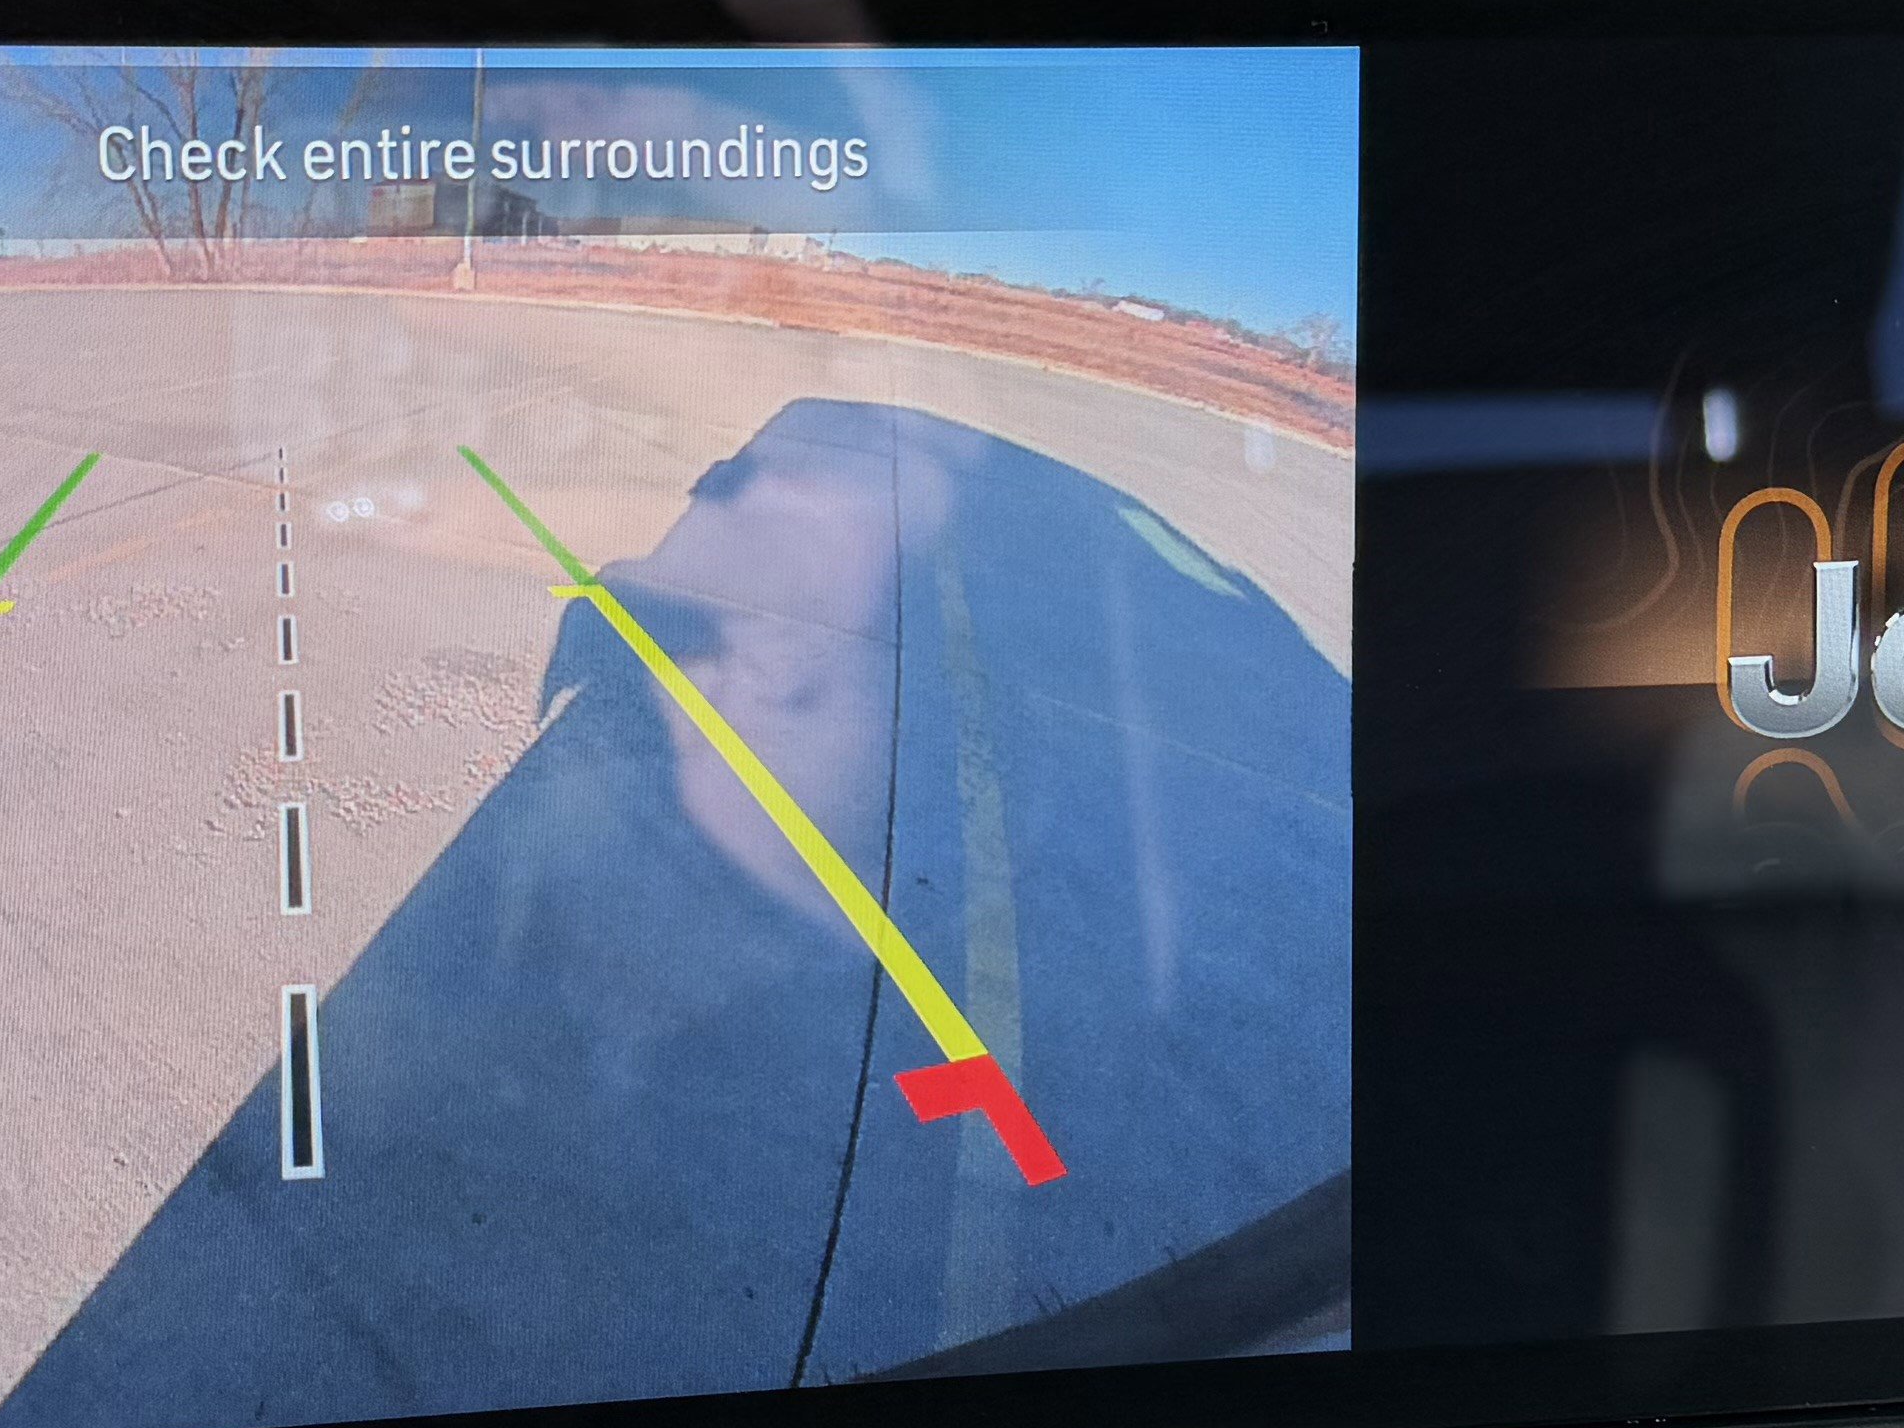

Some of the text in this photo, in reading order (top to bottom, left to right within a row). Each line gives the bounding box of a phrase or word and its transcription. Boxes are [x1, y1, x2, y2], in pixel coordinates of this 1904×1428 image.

[98, 124, 869, 192] Check entire surroundings
